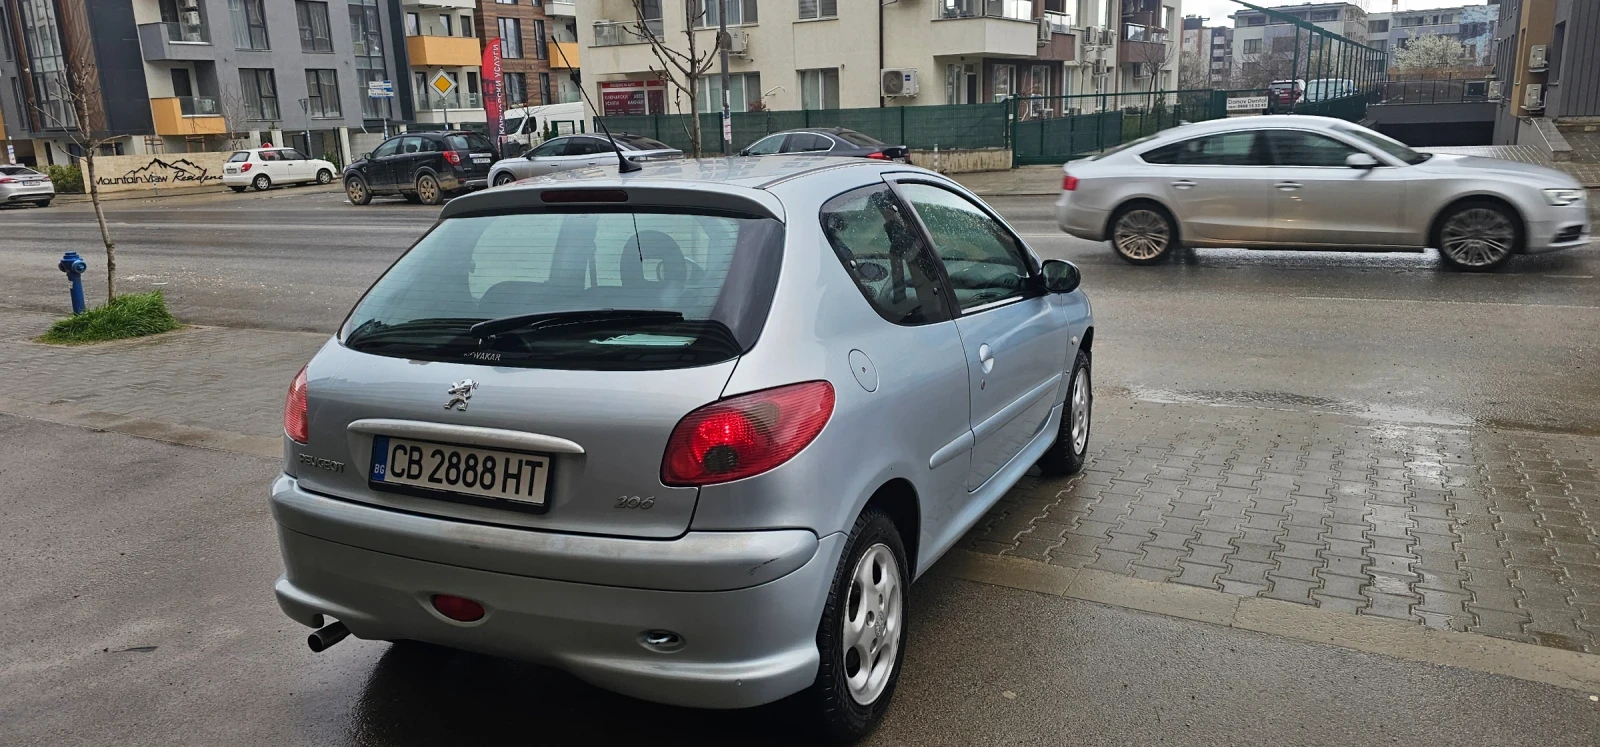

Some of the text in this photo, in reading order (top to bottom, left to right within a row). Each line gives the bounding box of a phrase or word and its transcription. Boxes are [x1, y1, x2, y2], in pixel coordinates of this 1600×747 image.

[492, 44, 501, 78] УСЛУГИ
[96, 174, 143, 185] Mountain
[172, 168, 223, 184] Residenc
[299, 453, 345, 473] PEUGEOT
[374, 463, 385, 474] BG
[390, 444, 544, 497] CB 2888 HT
[614, 495, 656, 510] 206
